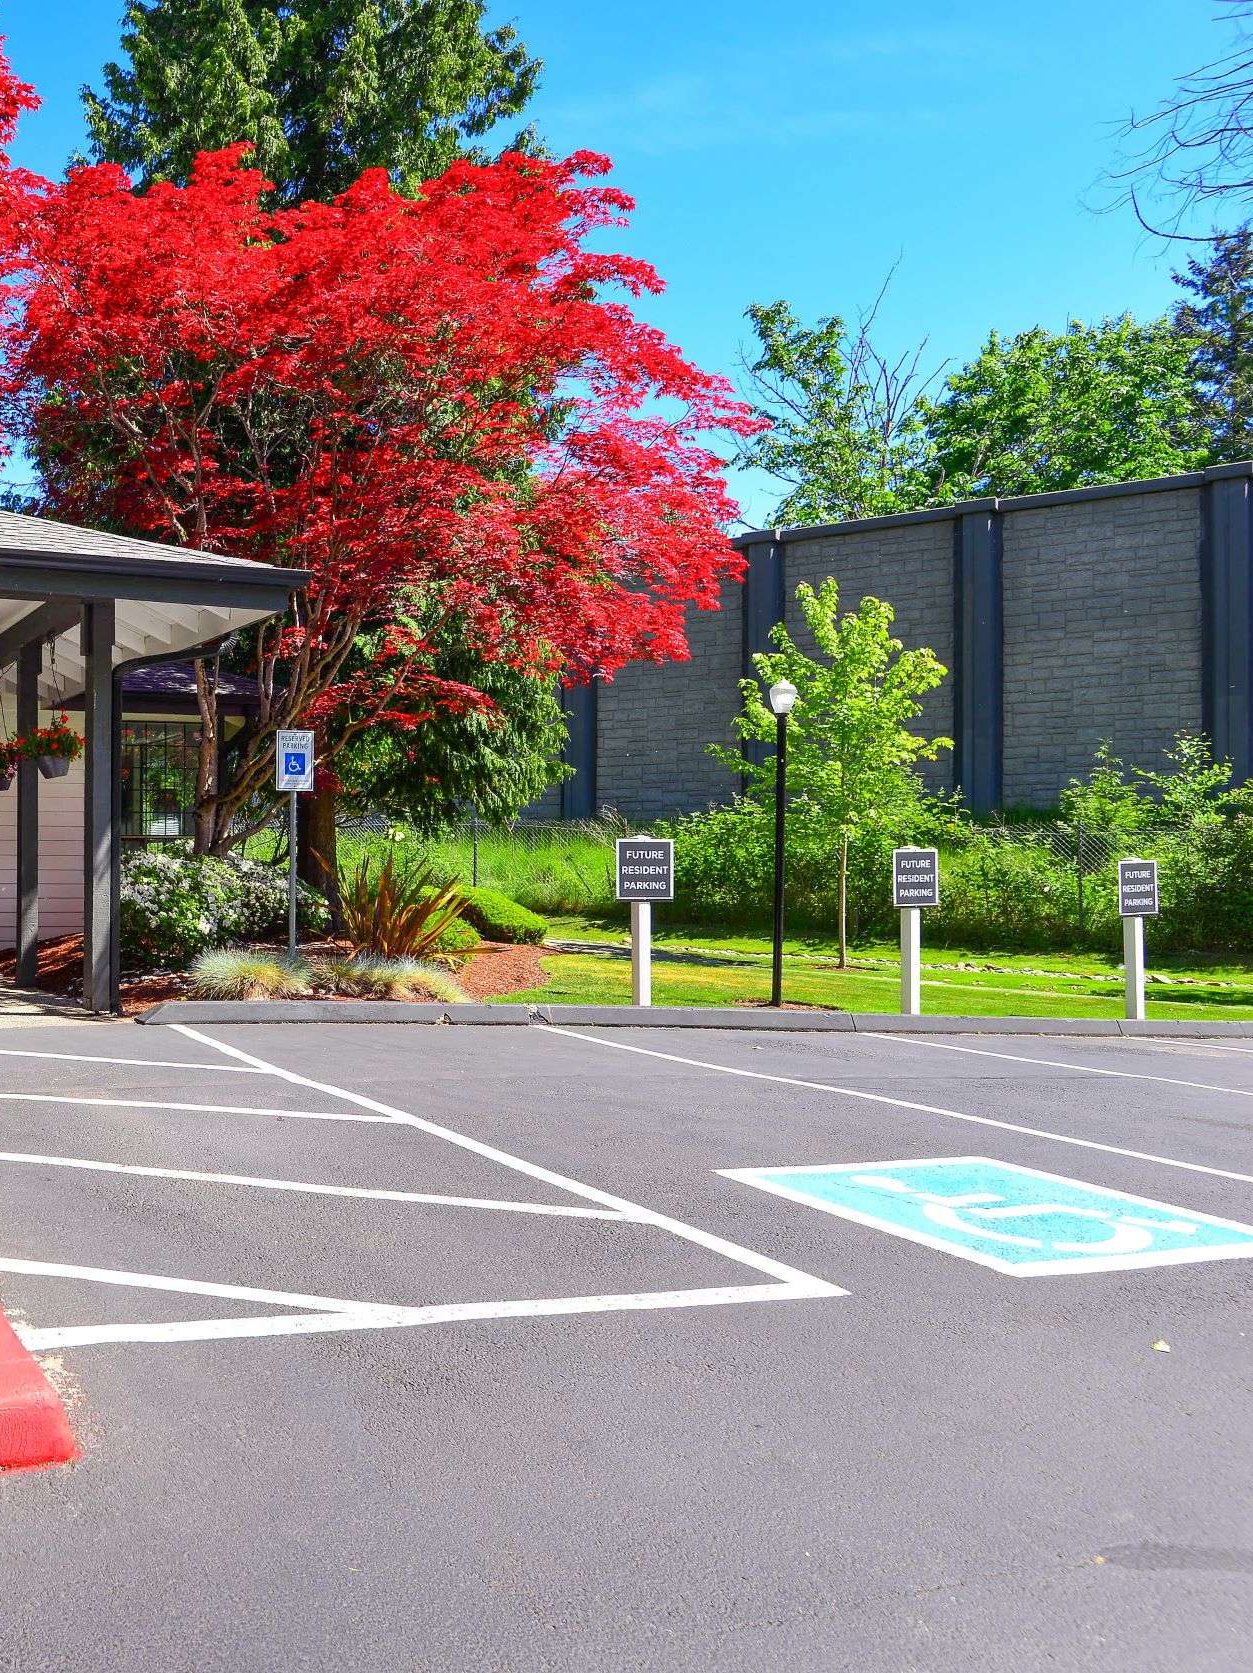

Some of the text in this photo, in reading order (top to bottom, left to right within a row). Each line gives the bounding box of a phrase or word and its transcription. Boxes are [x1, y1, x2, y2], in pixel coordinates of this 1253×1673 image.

[282, 742, 309, 750] PARKING
[626, 850, 665, 860] FUTURE
[900, 859, 932, 869] FUTURE
[621, 865, 669, 875] RESIDENT
[1124, 870, 1152, 879] FUTURE
[897, 874, 935, 883] RESIDENT
[623, 881, 667, 890] PARKING
[1122, 883, 1154, 893] RESIDENT
[899, 888, 933, 898] PARKING
[1124, 897, 1154, 907] PARKING
